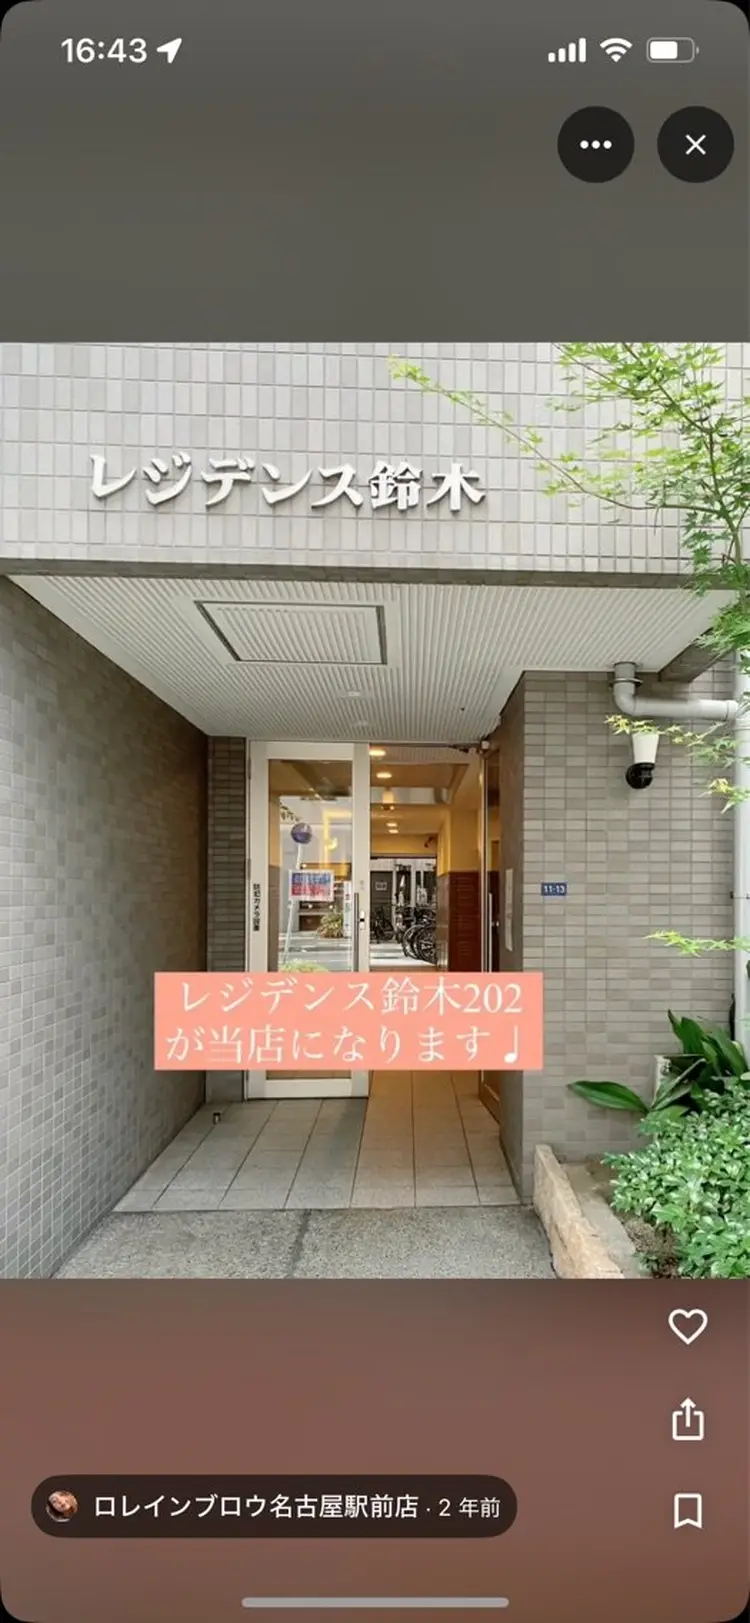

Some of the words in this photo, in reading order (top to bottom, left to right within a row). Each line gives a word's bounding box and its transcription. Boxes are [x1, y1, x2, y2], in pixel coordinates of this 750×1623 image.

[90, 450, 487, 513] レジデンス鈴木
